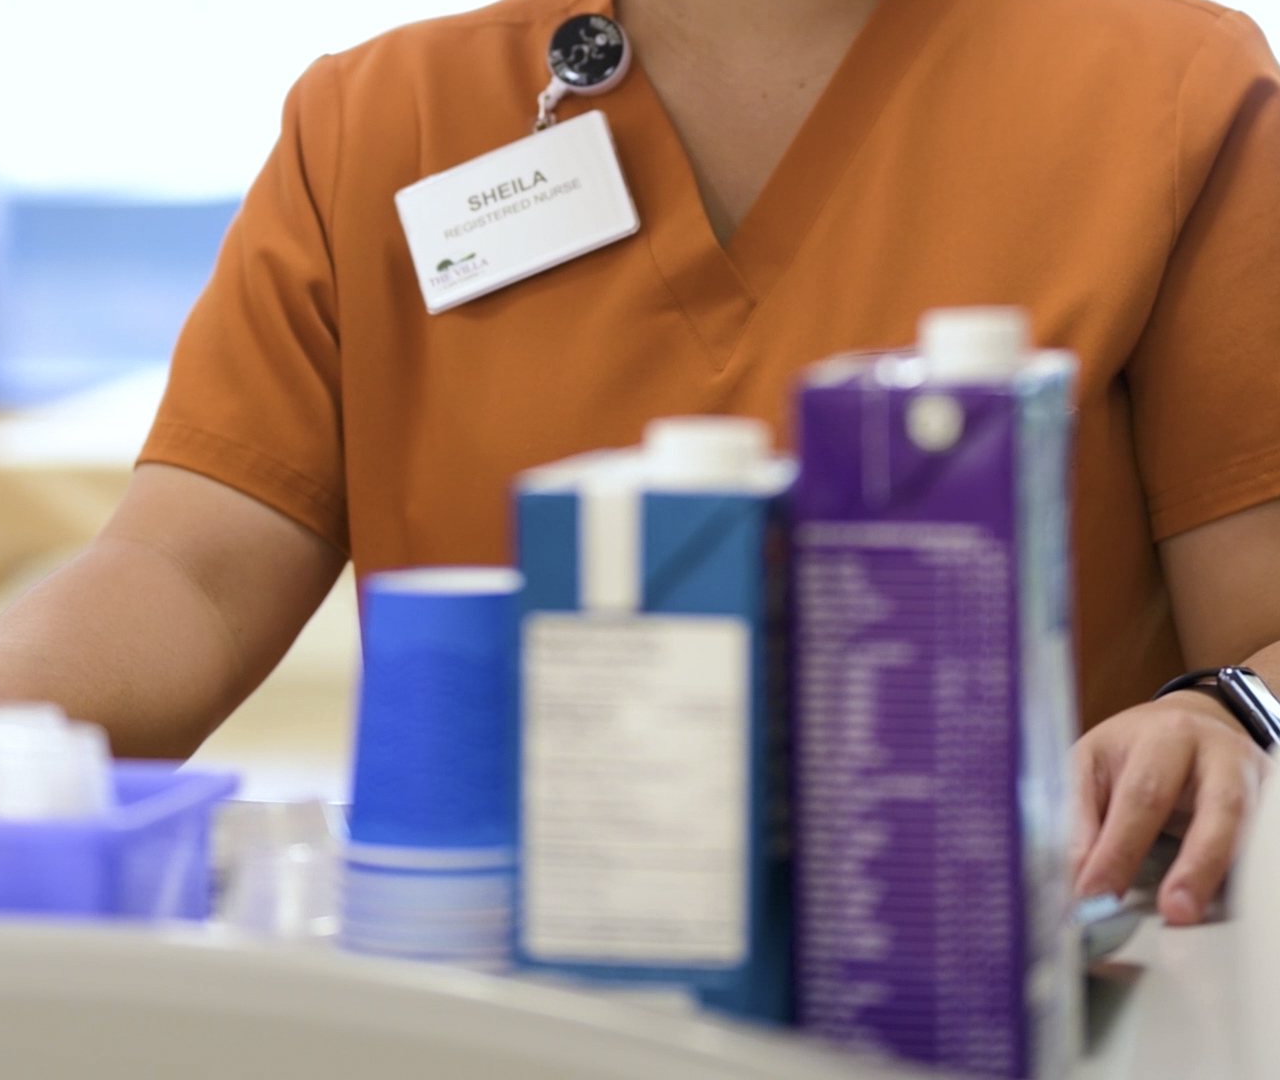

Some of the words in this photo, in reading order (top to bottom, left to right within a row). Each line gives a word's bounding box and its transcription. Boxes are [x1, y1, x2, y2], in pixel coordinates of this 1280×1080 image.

[445, 199, 531, 239] REGISTERED
[534, 178, 581, 203] NURSE
[468, 170, 548, 211] SHEILA
[453, 258, 488, 275] VILLA
